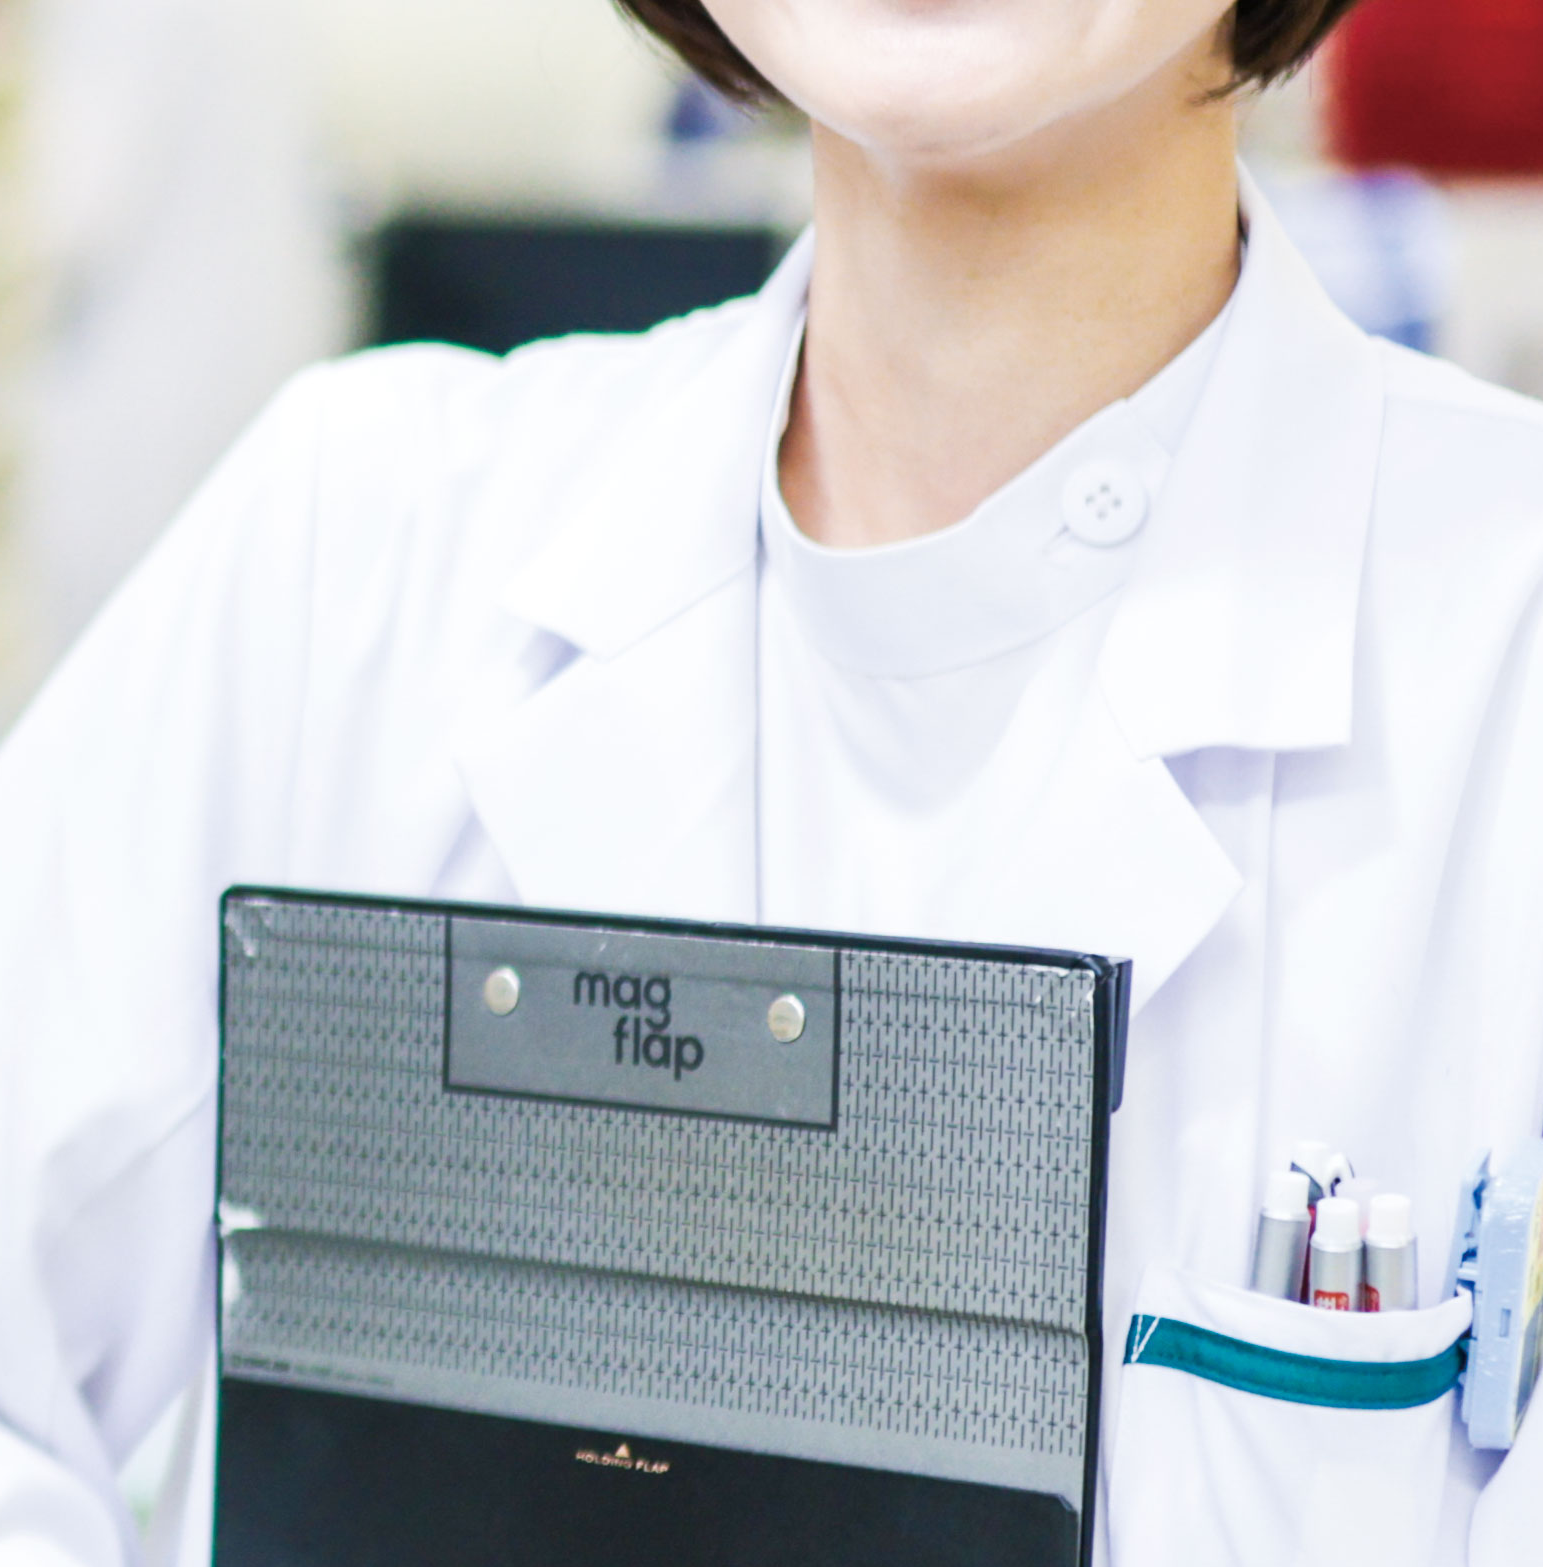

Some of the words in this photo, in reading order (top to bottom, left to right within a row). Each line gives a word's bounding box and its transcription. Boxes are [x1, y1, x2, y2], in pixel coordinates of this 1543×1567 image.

[573, 970, 672, 1032] mag
[614, 1013, 705, 1083] flap
[575, 1449, 634, 1470] HOLDING
[634, 1458, 671, 1474] FLAP
